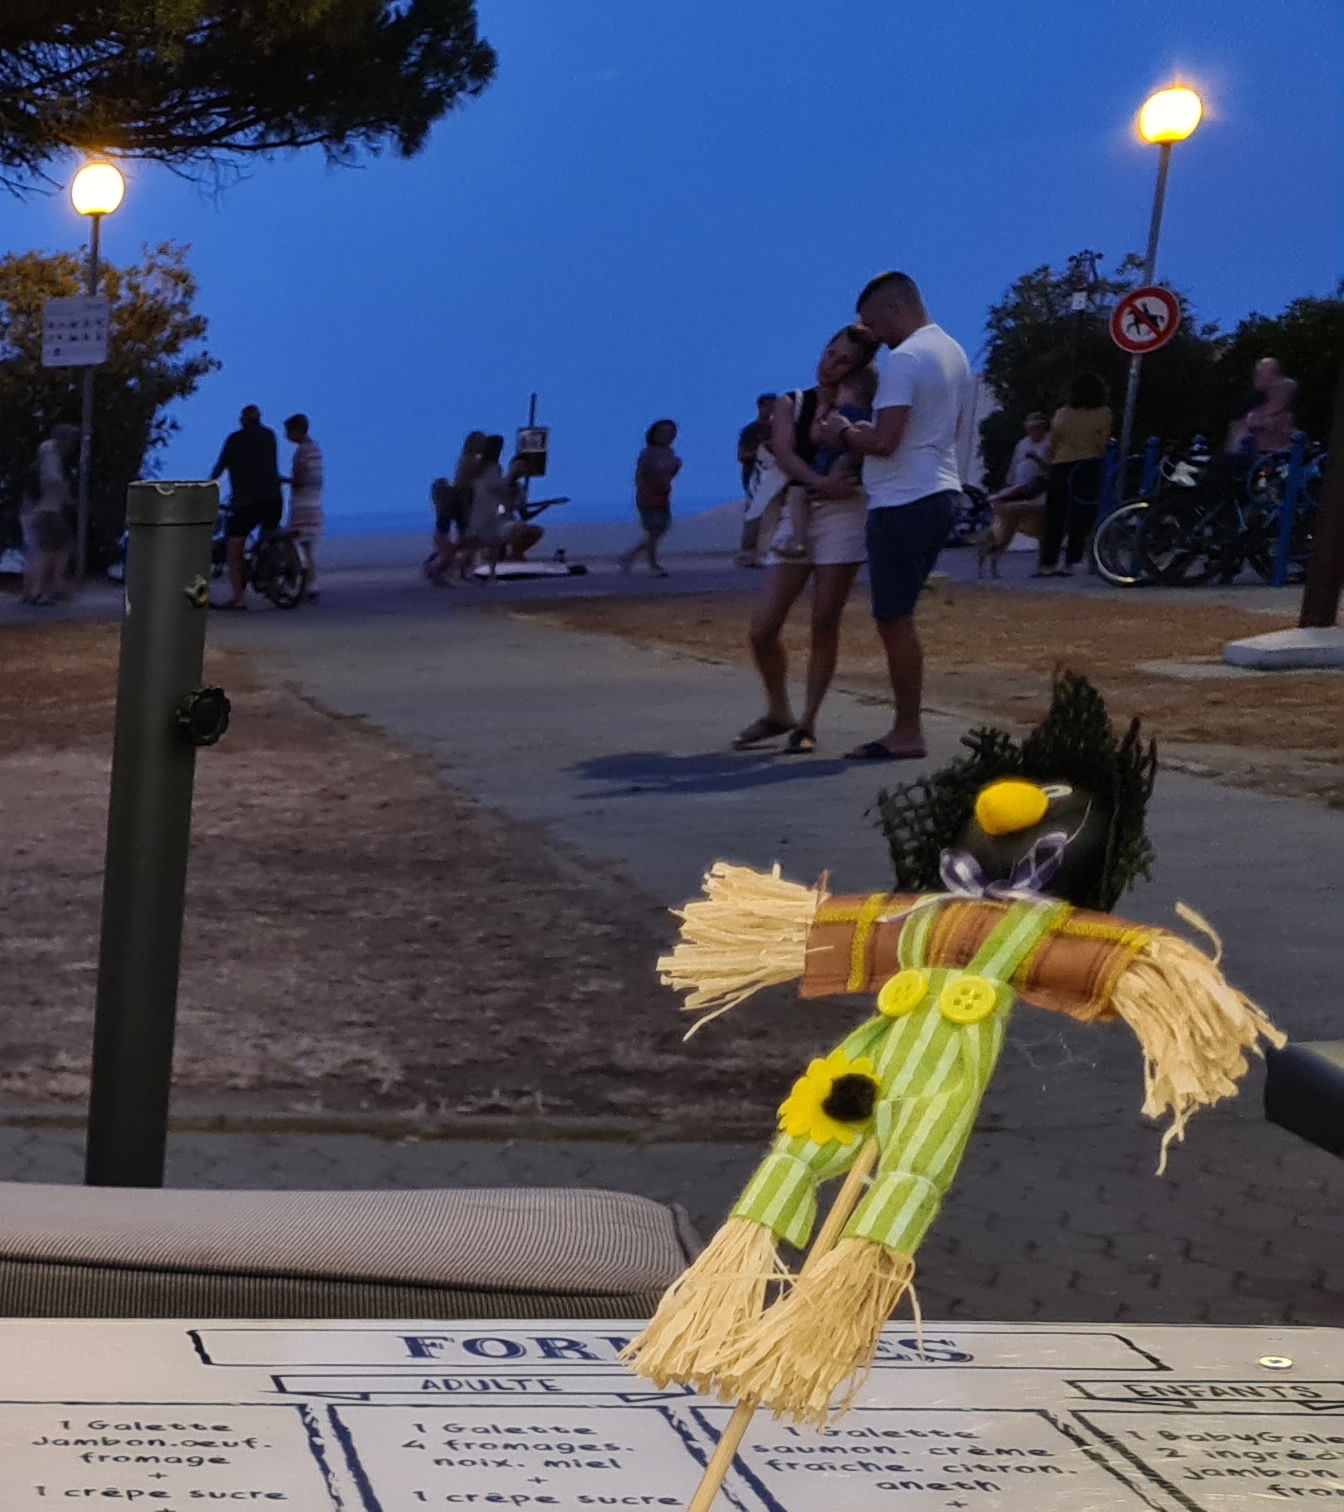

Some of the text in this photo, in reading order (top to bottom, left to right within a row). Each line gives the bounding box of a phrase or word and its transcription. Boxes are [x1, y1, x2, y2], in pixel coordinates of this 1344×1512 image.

[421, 1378, 563, 1392] ADULTE
[1122, 1384, 1323, 1399] ENFANTS
[60, 1419, 232, 1432] 1 Galette
[413, 1423, 597, 1435] 1 Galette
[783, 1426, 801, 1437] 1
[928, 1444, 1055, 1457] crème
[79, 1451, 230, 1468] fromage
[543, 1457, 622, 1469] miel
[876, 1479, 1001, 1493] aneth
[35, 1485, 288, 1502] 1 crêpe sucre
[412, 1490, 683, 1507] 1 crêpe sucre
